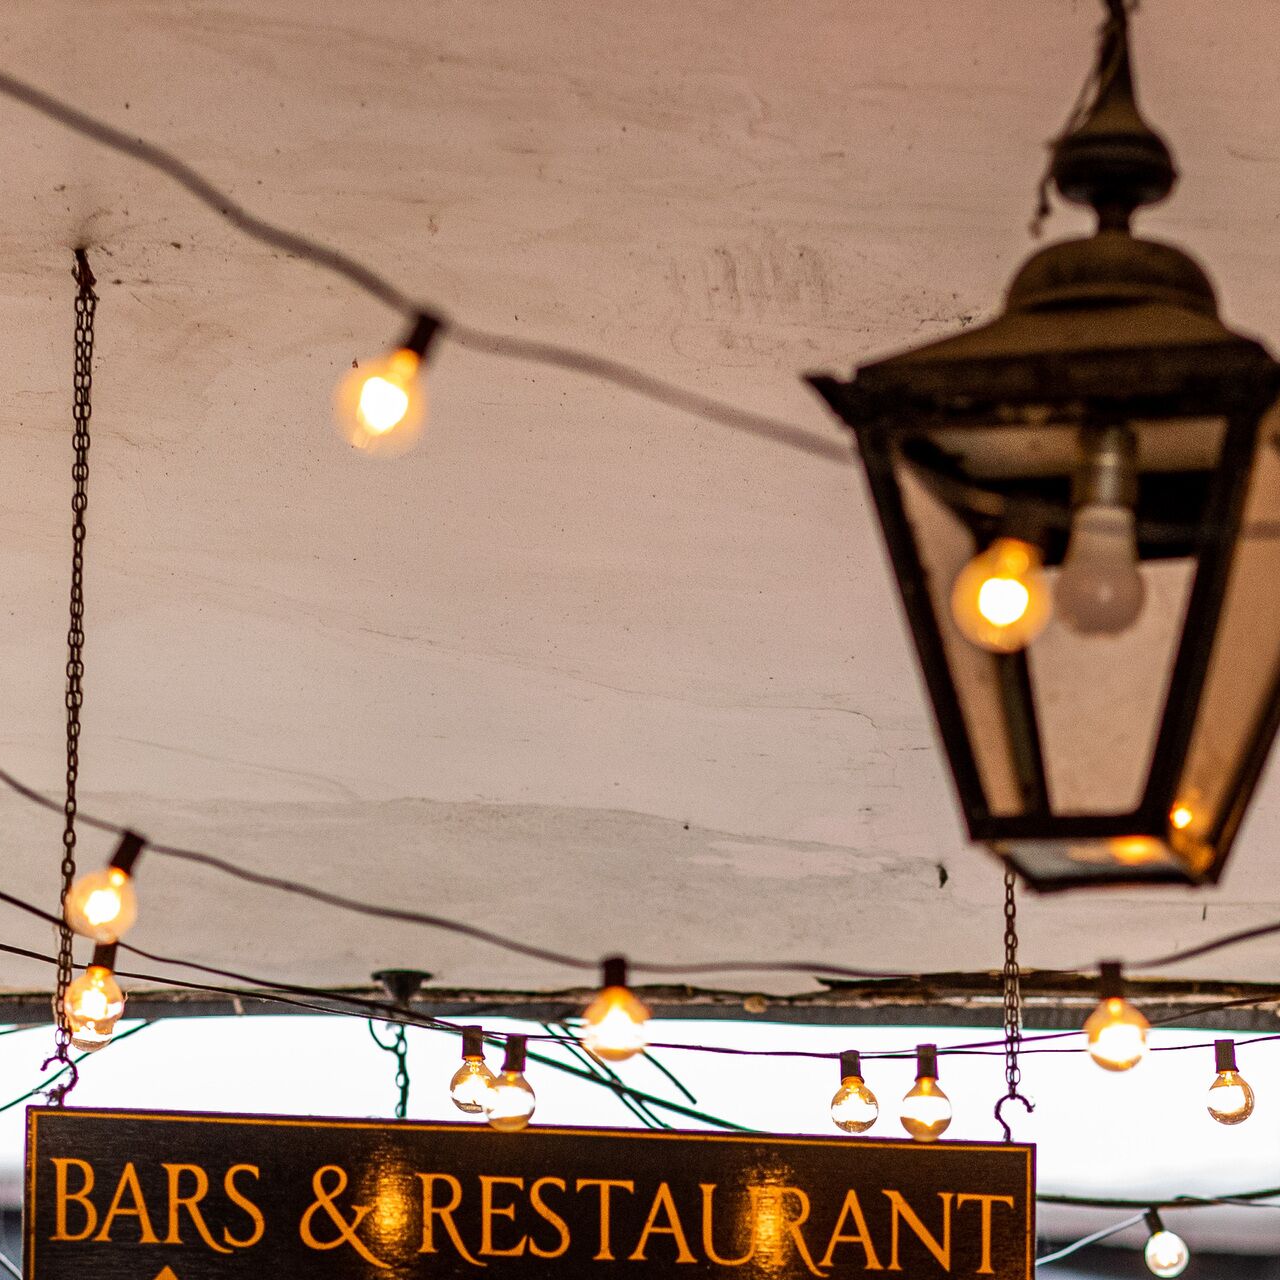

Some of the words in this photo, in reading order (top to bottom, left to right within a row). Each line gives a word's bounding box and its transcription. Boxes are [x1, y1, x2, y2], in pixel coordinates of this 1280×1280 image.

[50, 1157, 267, 1255] BARS
[299, 1163, 395, 1269] &
[418, 1172, 1015, 1279] RESTAURANT
